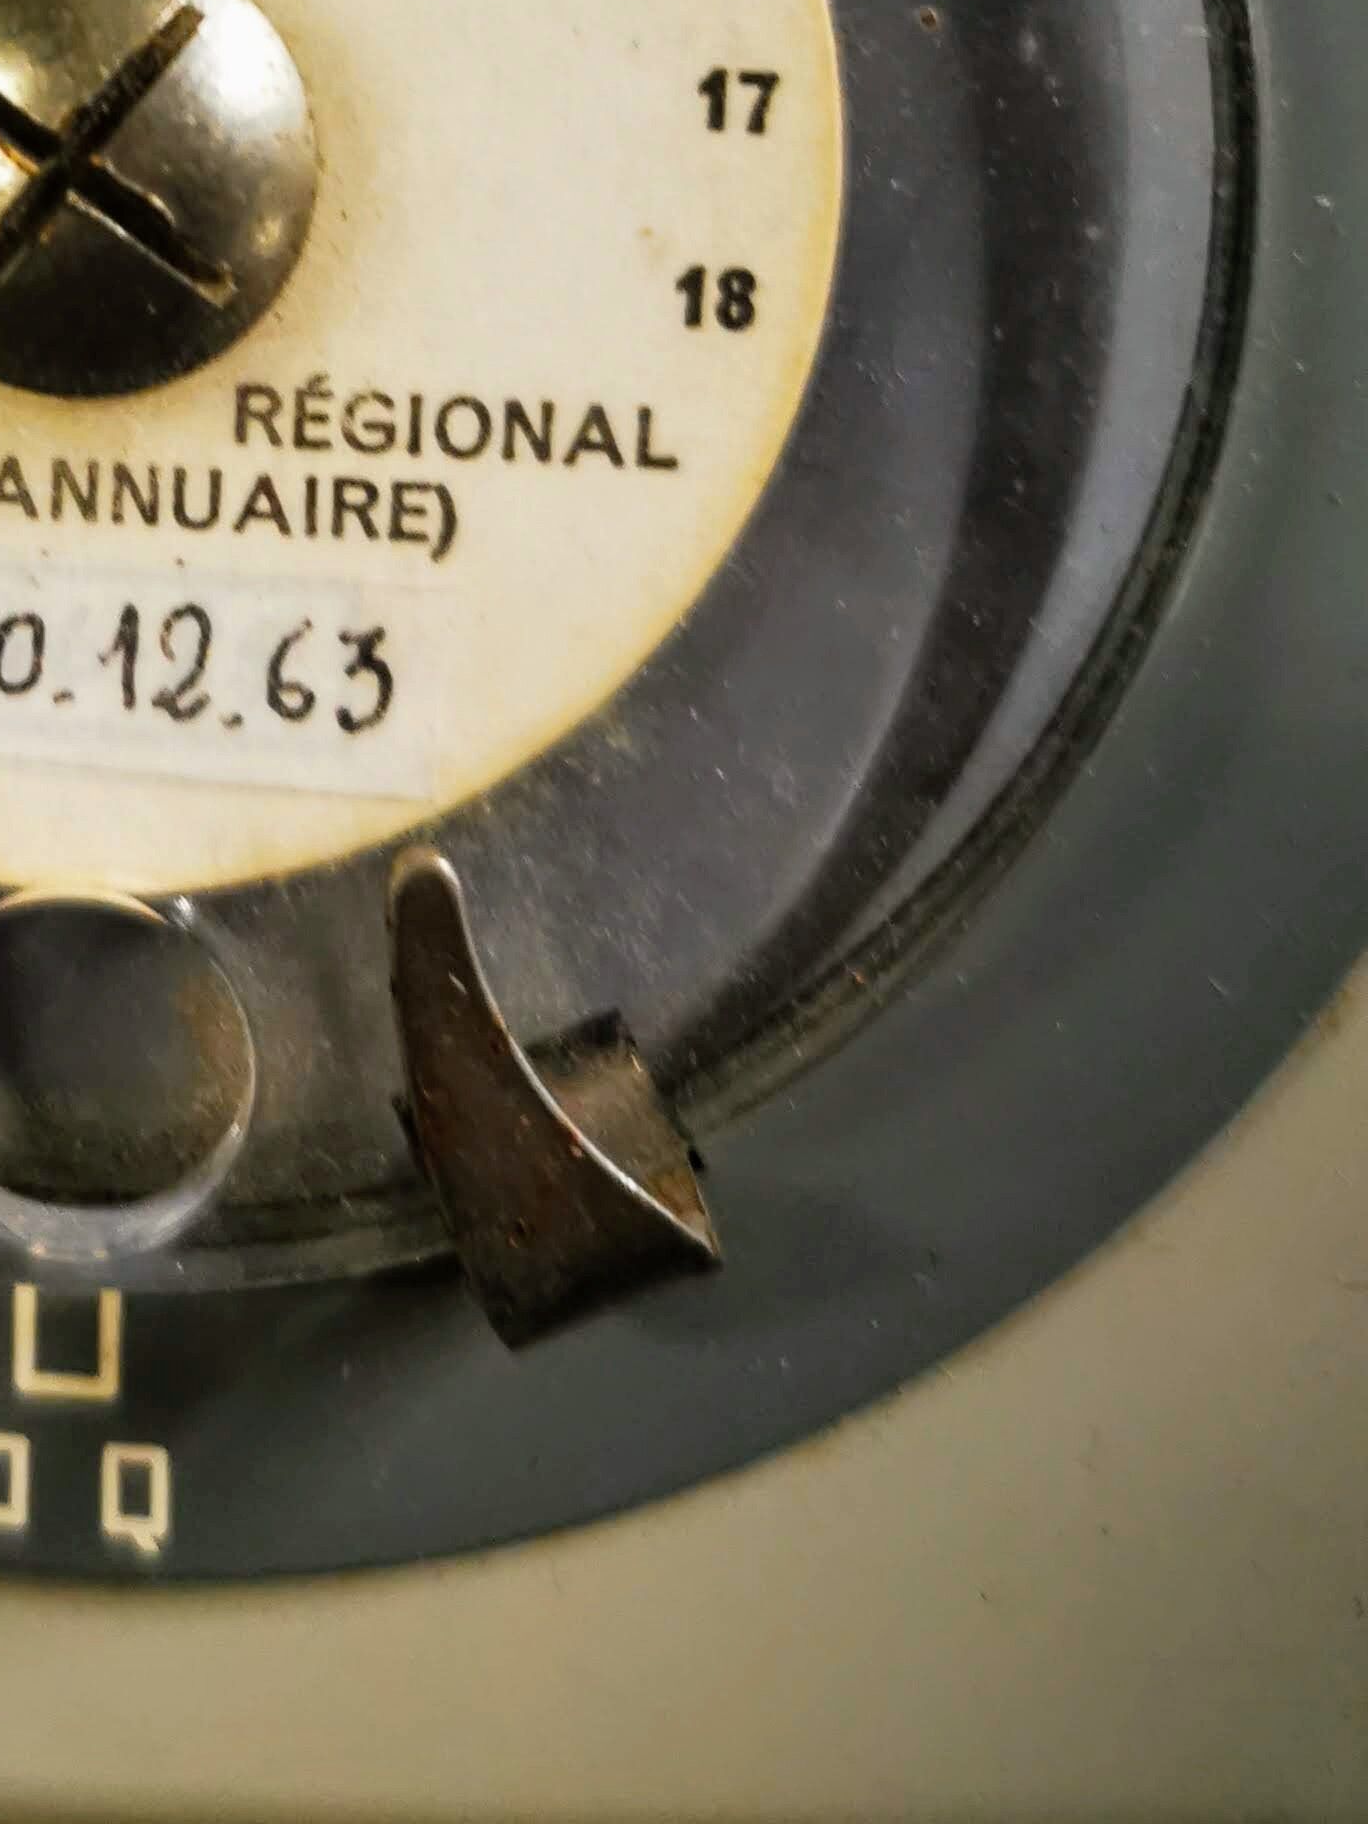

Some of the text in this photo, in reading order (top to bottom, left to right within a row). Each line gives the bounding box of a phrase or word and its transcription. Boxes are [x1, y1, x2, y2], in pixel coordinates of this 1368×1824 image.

[697, 68, 781, 136] 17
[675, 264, 757, 332] 18
[233, 373, 679, 471] RÉGIONAL
